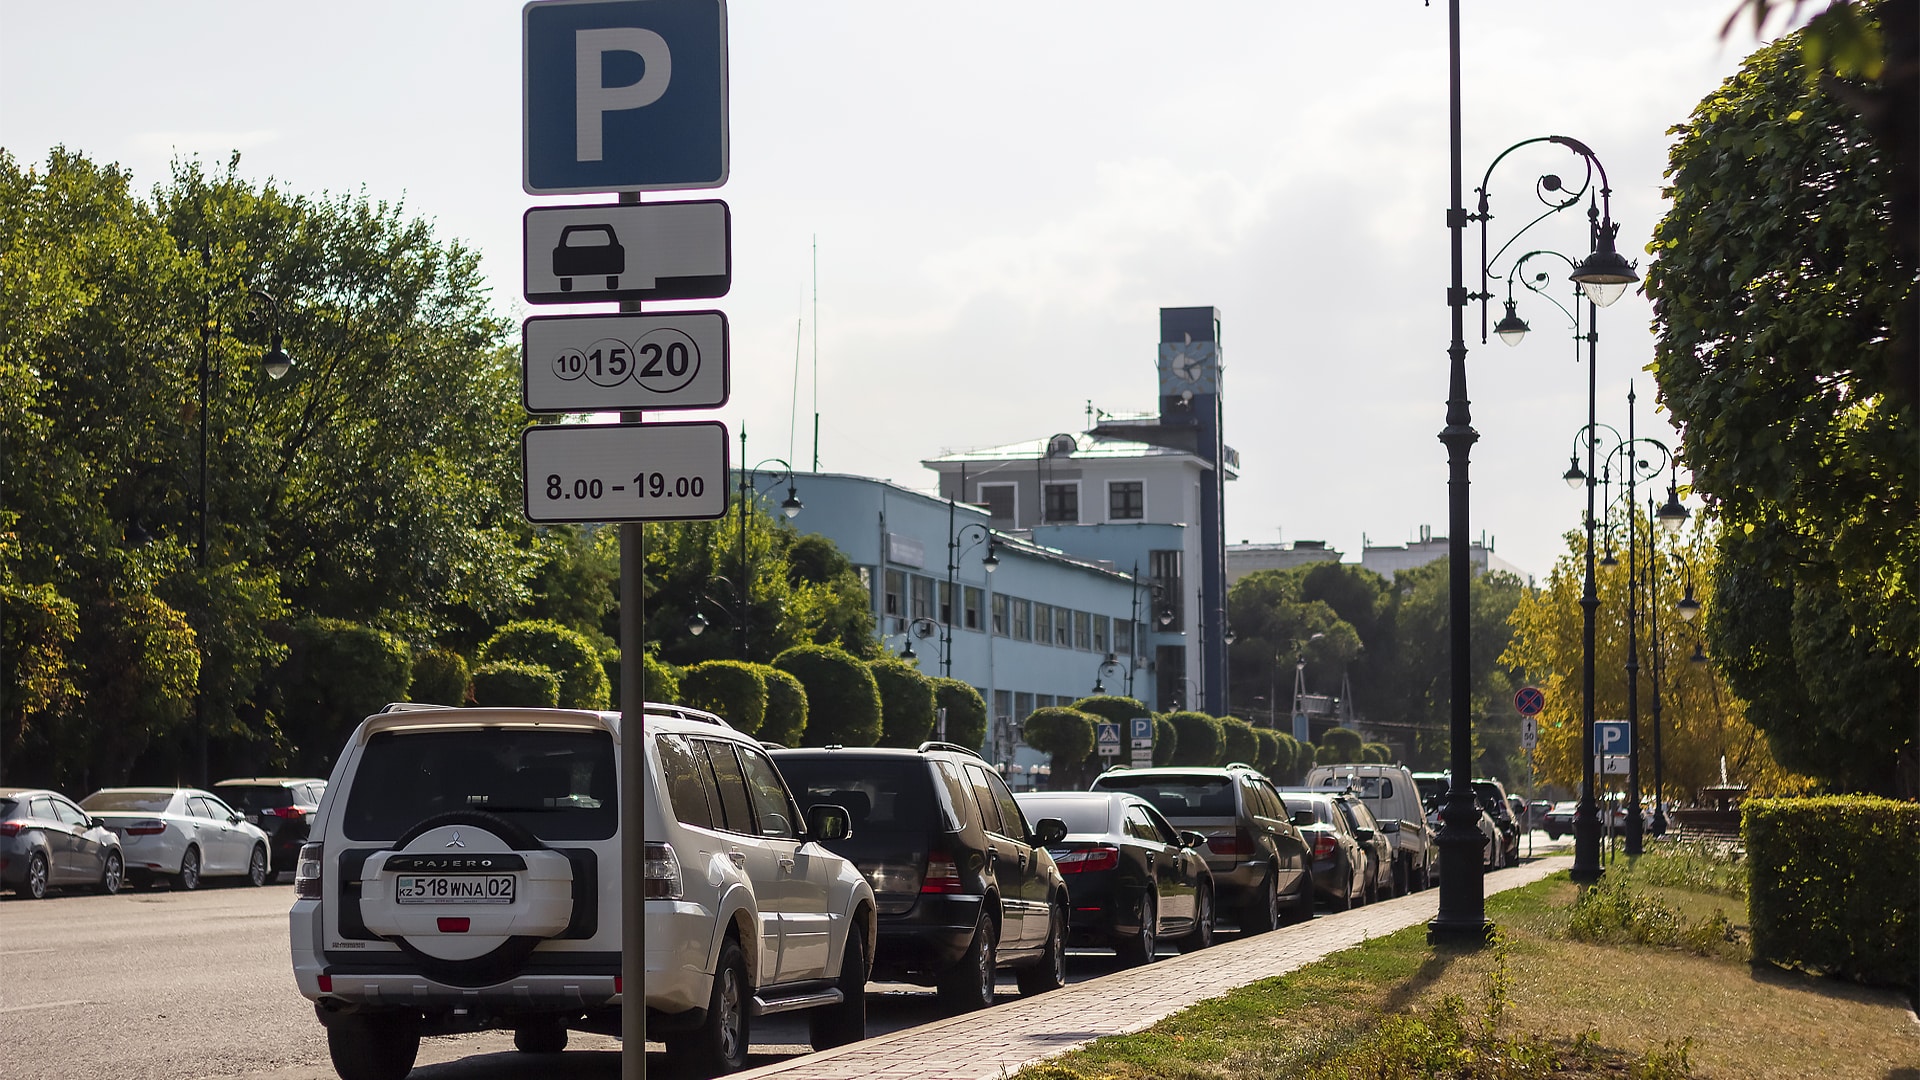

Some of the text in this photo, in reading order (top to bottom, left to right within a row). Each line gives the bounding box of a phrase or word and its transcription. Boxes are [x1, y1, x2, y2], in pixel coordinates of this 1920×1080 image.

[576, 27, 672, 162] P
[557, 342, 689, 378] 10 15 20
[546, 474, 603, 500] 8.00
[633, 472, 704, 498] 19.00
[1136, 721, 1147, 737] P
[1603, 726, 1621, 751] P
[400, 878, 512, 897] KZ 518 WNA 02
